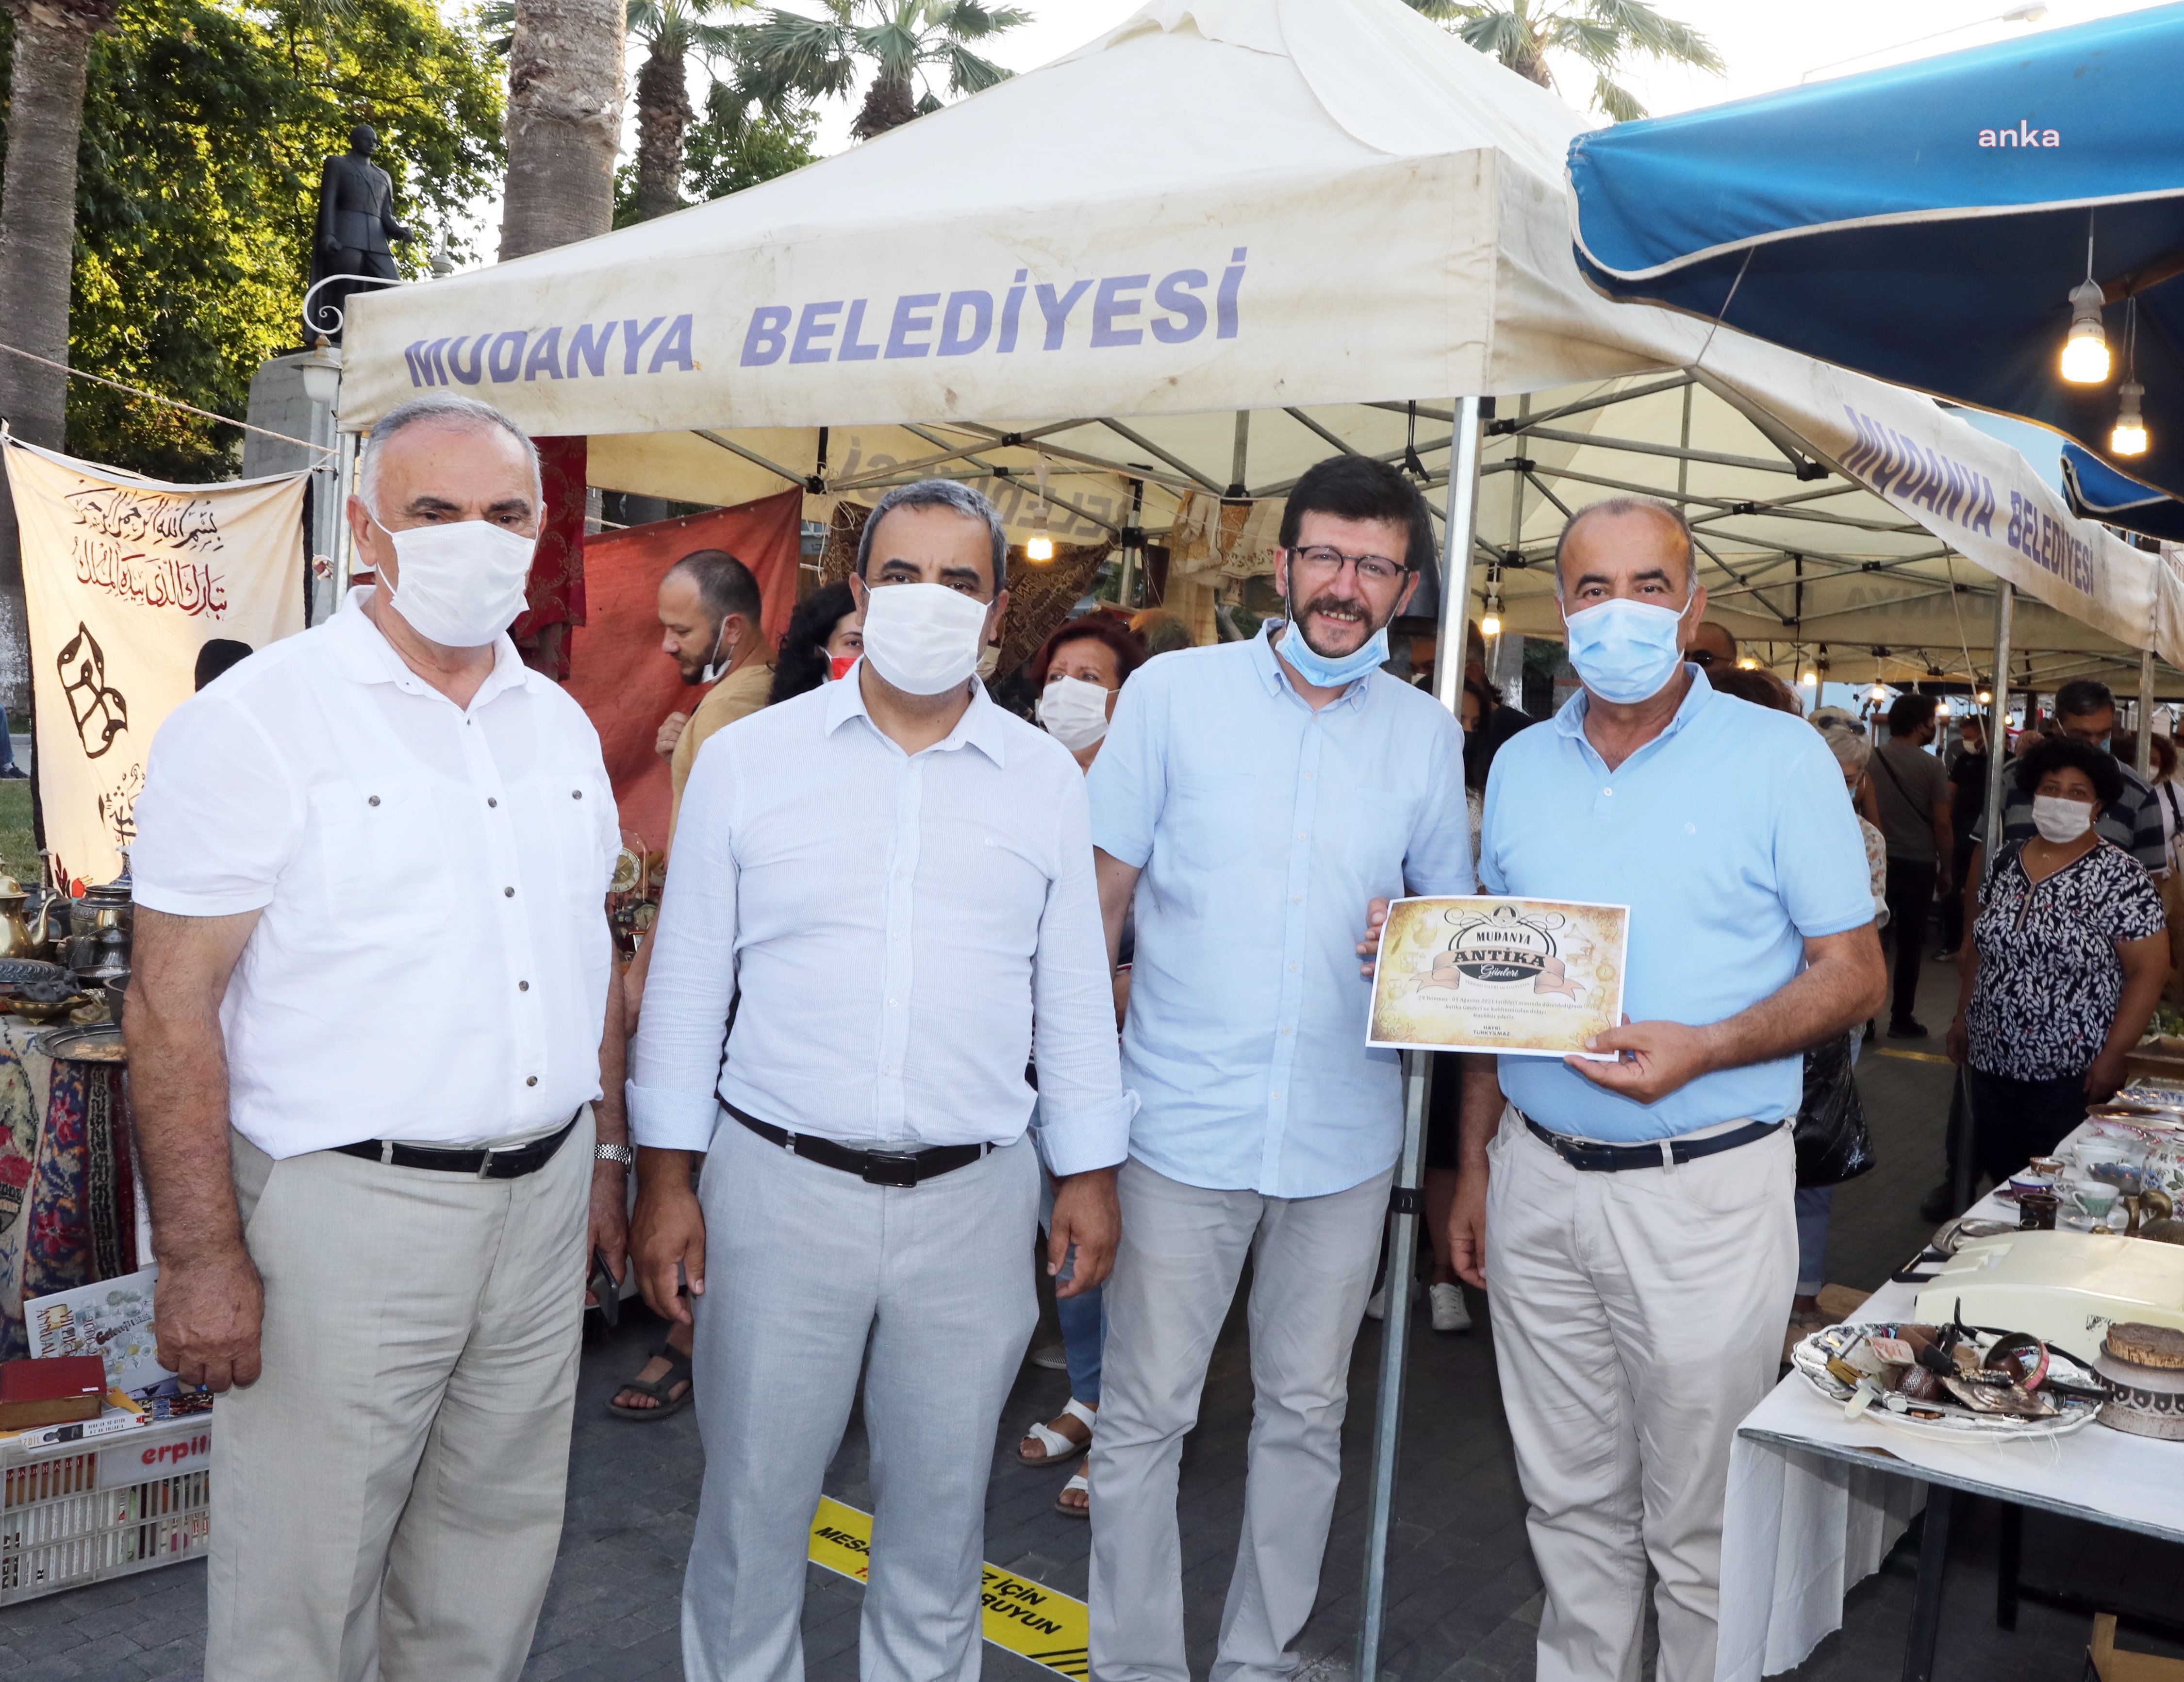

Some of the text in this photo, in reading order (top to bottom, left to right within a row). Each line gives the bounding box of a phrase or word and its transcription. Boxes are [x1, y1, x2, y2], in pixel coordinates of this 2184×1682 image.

[404, 247, 1247, 387] MUDANYA BELEDİYESİ
[1838, 404, 2094, 597] MUDANYA BELEDİYESİ
[1476, 931, 1531, 945] MUDANYA
[1452, 947, 1546, 967] ANTİKA
[1478, 964, 1519, 979] Günleri
[992, 1578, 1048, 1606] İÇİN
[981, 1592, 1063, 1635] RUYUN
